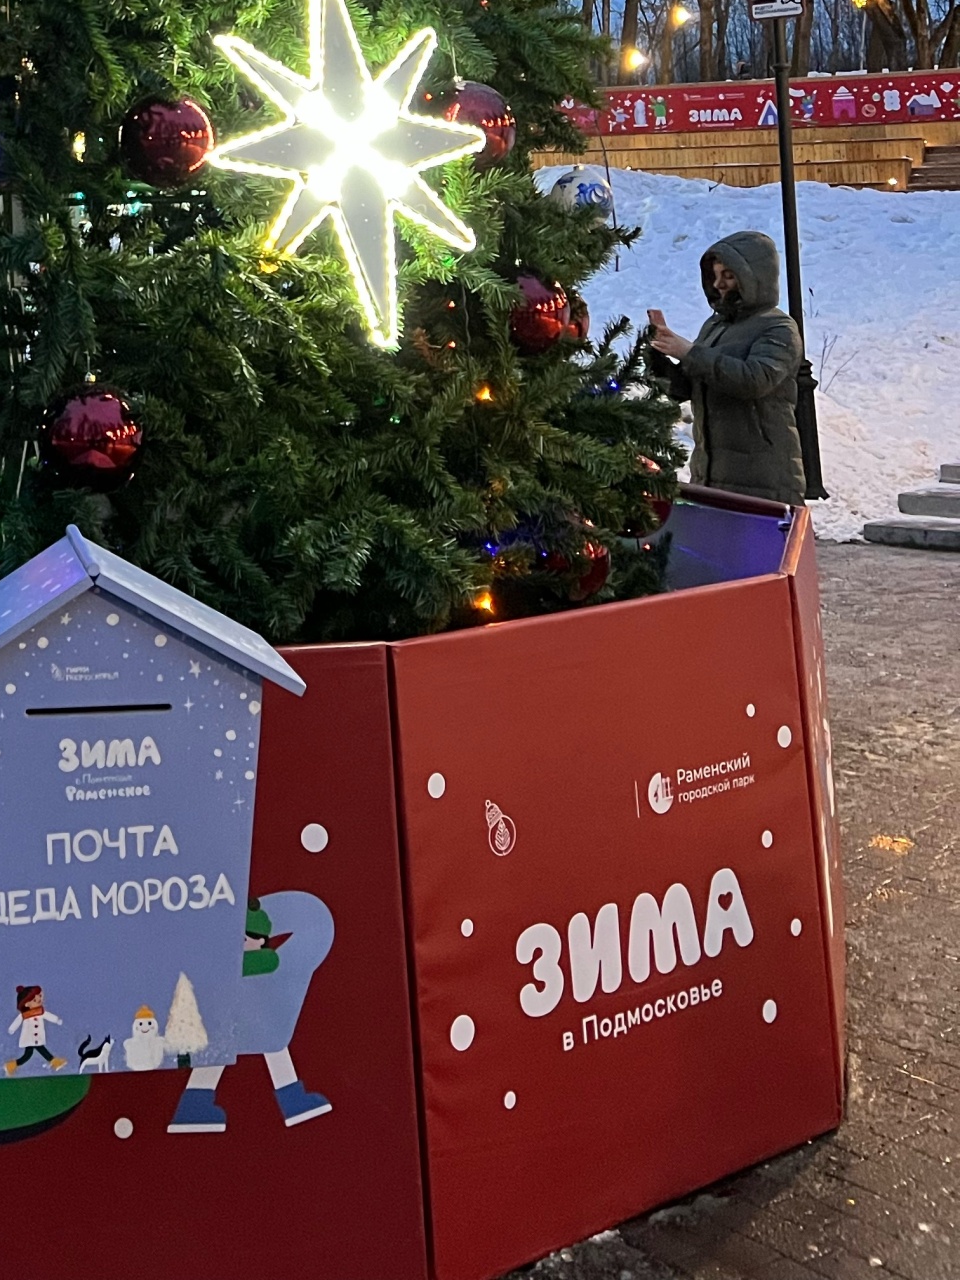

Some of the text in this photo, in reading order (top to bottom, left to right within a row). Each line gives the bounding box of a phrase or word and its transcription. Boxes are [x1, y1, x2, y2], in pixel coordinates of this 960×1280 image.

[689, 108, 743, 123] ЗИМА
[58, 736, 161, 773] ЗИМА
[677, 752, 751, 785] Раменский
[678, 774, 755, 803] городской парк
[47, 825, 179, 865] ПОЧТА
[91, 873, 236, 919] МОРОЗА
[516, 868, 754, 1018] ЗИМА
[563, 979, 723, 1051] в Подмосковье
